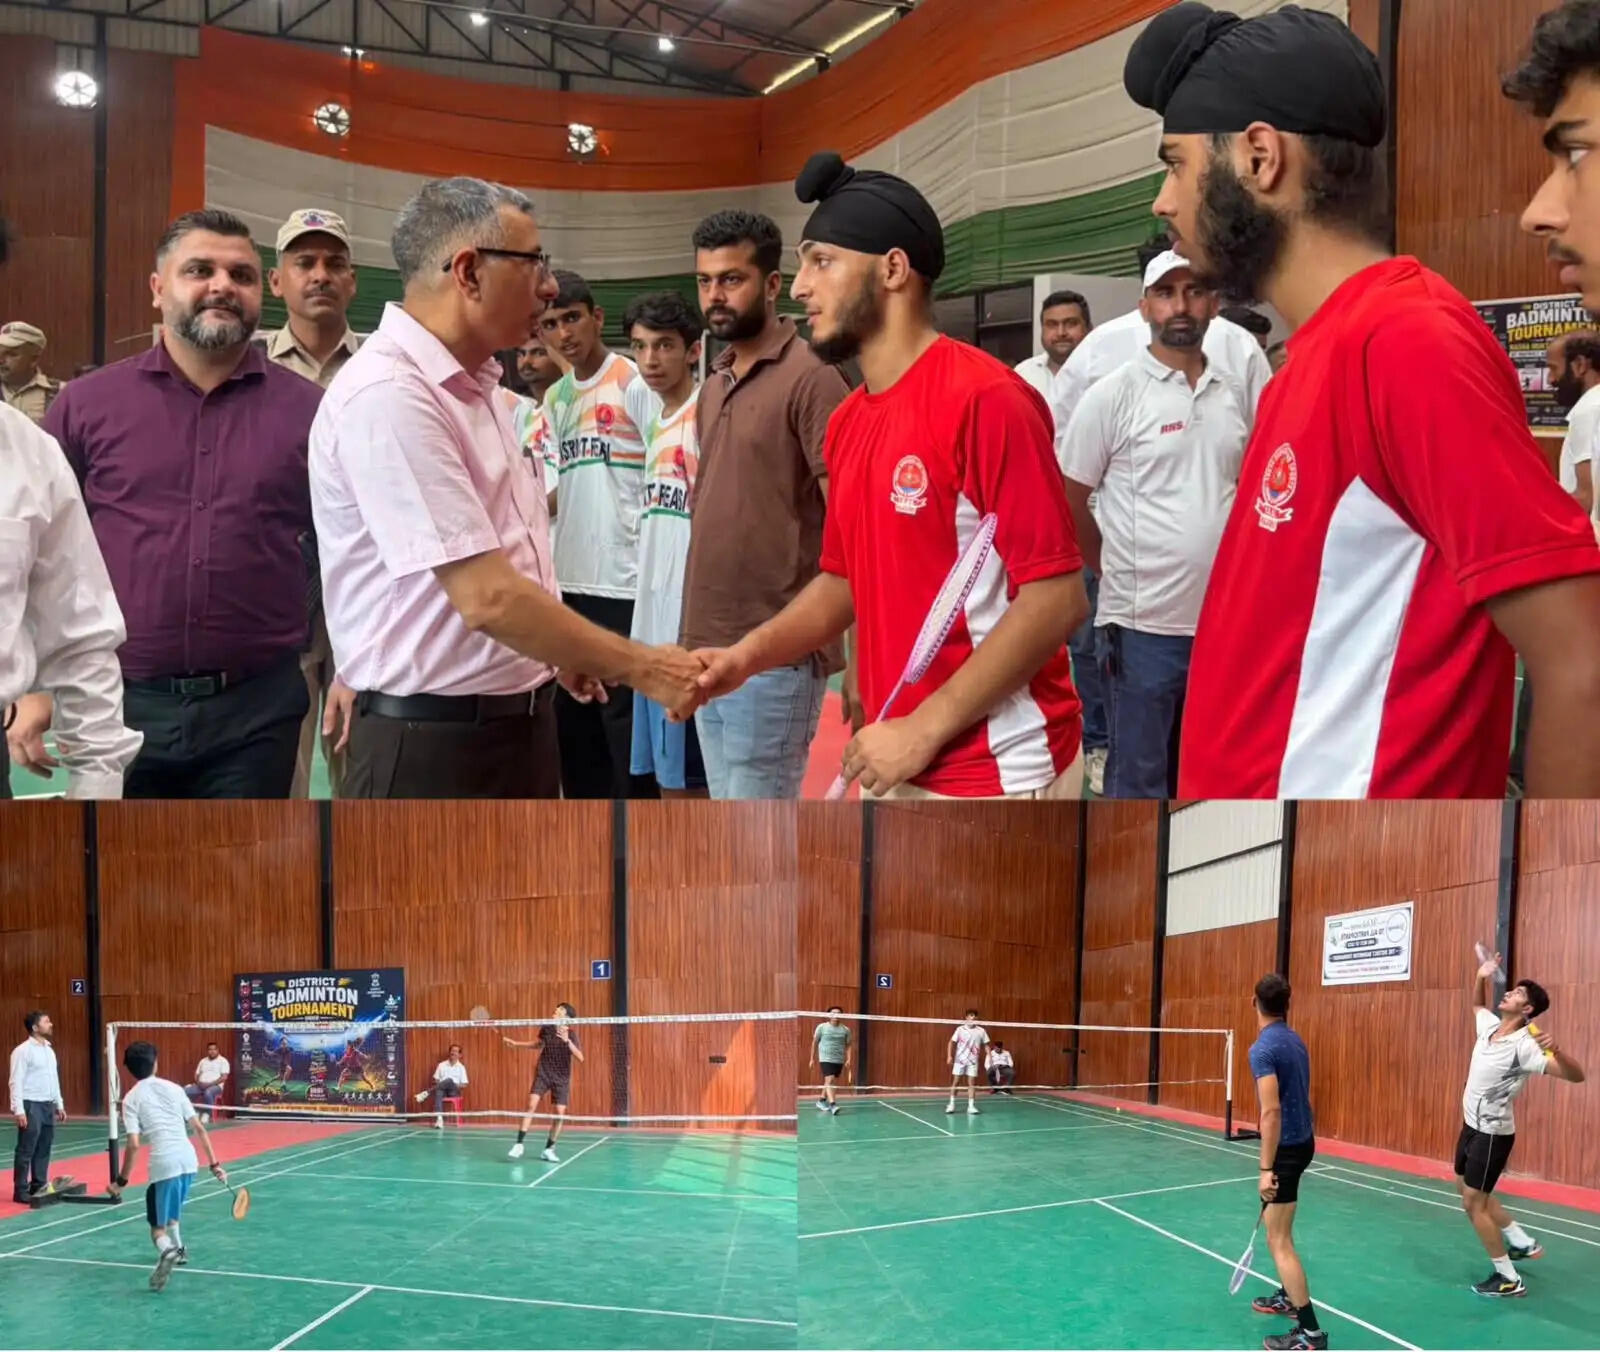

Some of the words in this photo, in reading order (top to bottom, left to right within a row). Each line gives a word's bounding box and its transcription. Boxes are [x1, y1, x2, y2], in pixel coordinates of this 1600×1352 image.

[1533, 300, 1576, 310] DISTRICT
[597, 963, 605, 976] 1
[75, 982, 82, 993] 2
[288, 977, 336, 988] DISTRICT
[267, 987, 358, 1009] BADMINTON
[270, 1001, 355, 1021] TOURNAMENT
